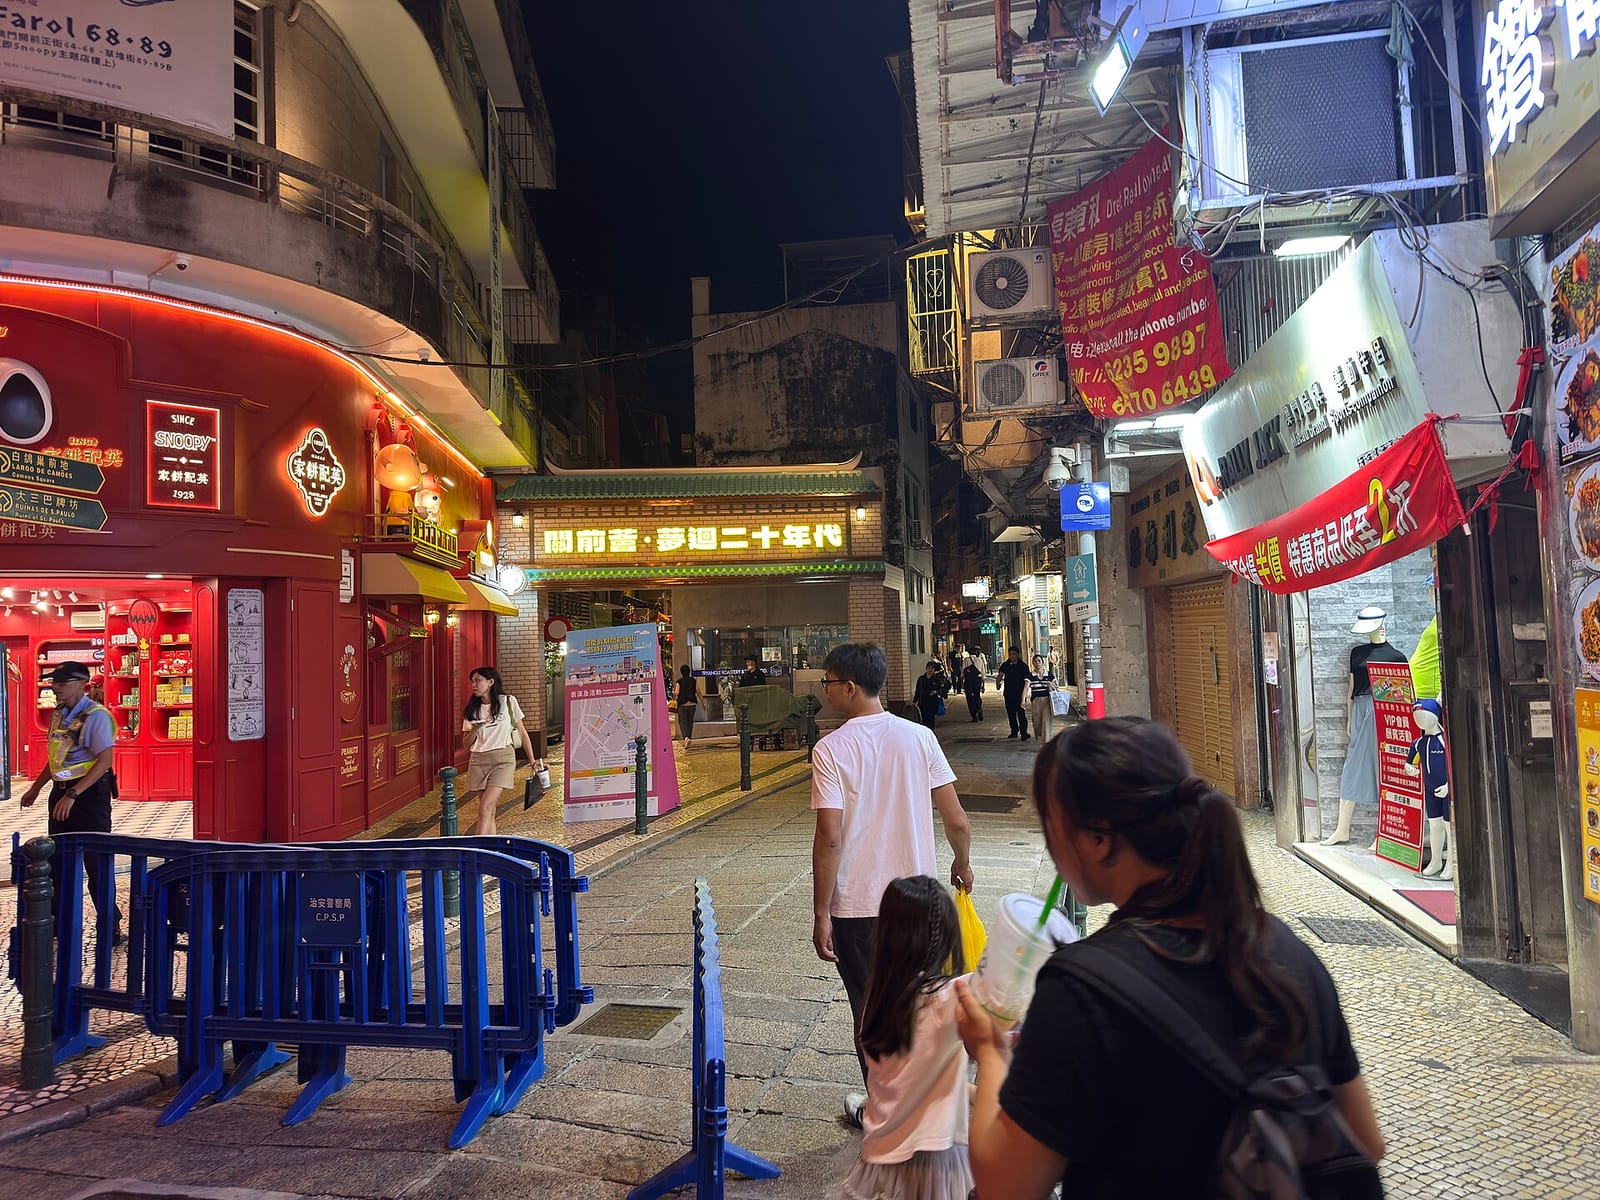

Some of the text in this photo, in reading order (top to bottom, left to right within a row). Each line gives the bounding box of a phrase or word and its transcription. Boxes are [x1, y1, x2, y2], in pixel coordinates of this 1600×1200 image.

[1140, 314, 1175, 341] phone
[1153, 323, 1206, 366] 9897
[1161, 364, 1216, 405] 6439
[171, 414, 195, 426] SINCE
[1253, 414, 1289, 470] JACK
[12, 463, 34, 473] LARGO
[47, 468, 73, 479] CAMÕES
[16, 490, 78, 511] 大三巴牌坊
[172, 490, 195, 499] 1928
[309, 898, 351, 909] 治安警察局
